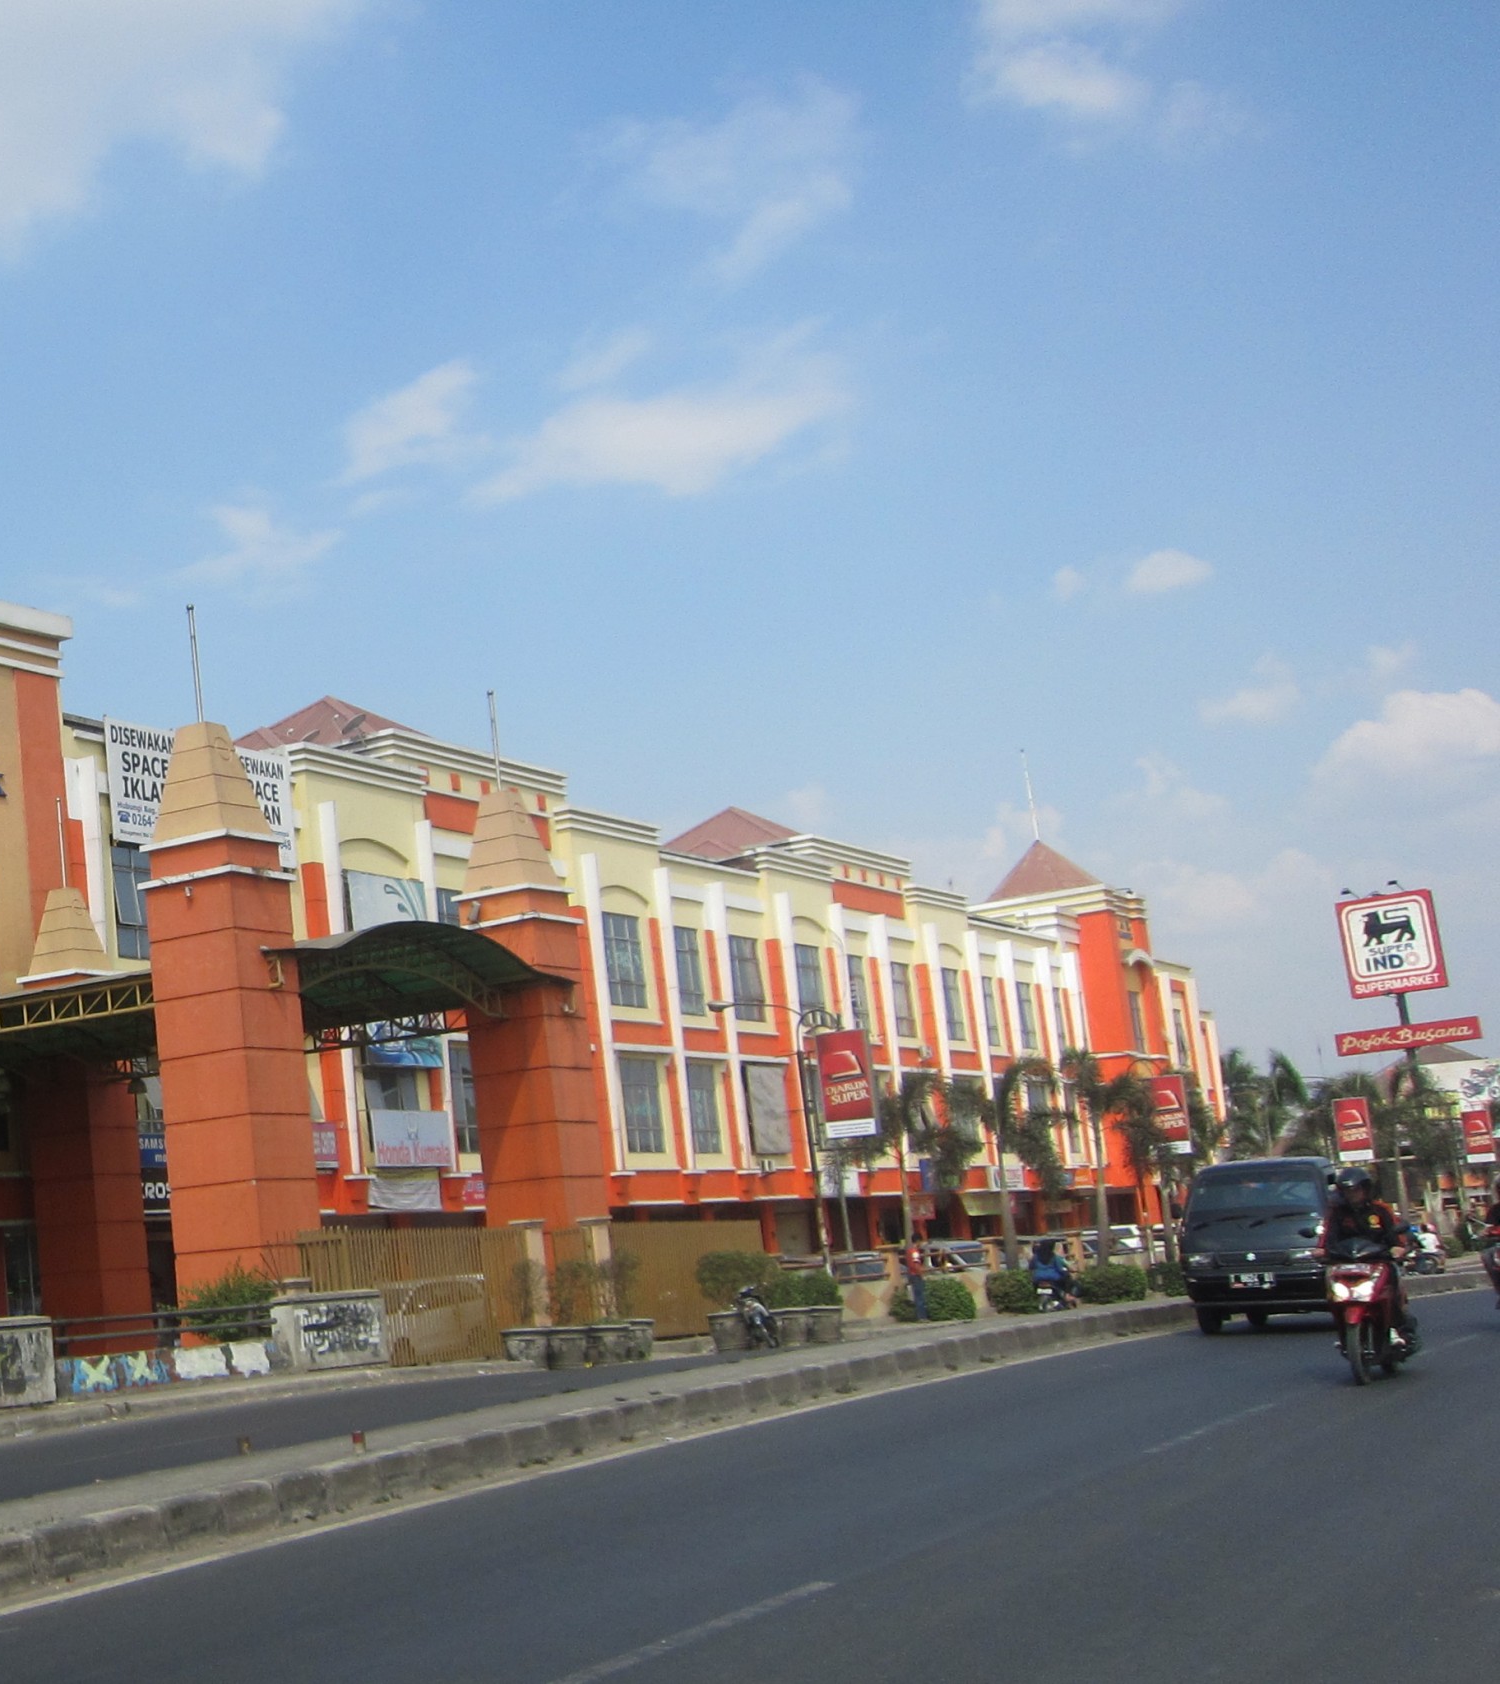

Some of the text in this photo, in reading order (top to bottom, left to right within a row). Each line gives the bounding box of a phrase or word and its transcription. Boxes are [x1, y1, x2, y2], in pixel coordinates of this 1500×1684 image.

[122, 775, 164, 803] IKLA
[1368, 942, 1414, 956] SUPER
[1365, 951, 1421, 973] INDO
[1355, 973, 1440, 994] SUPERMARKET
[1342, 1025, 1473, 1052] Pojok Busana
[831, 1089, 870, 1105] SUPER
[139, 1138, 164, 1150] SAMS
